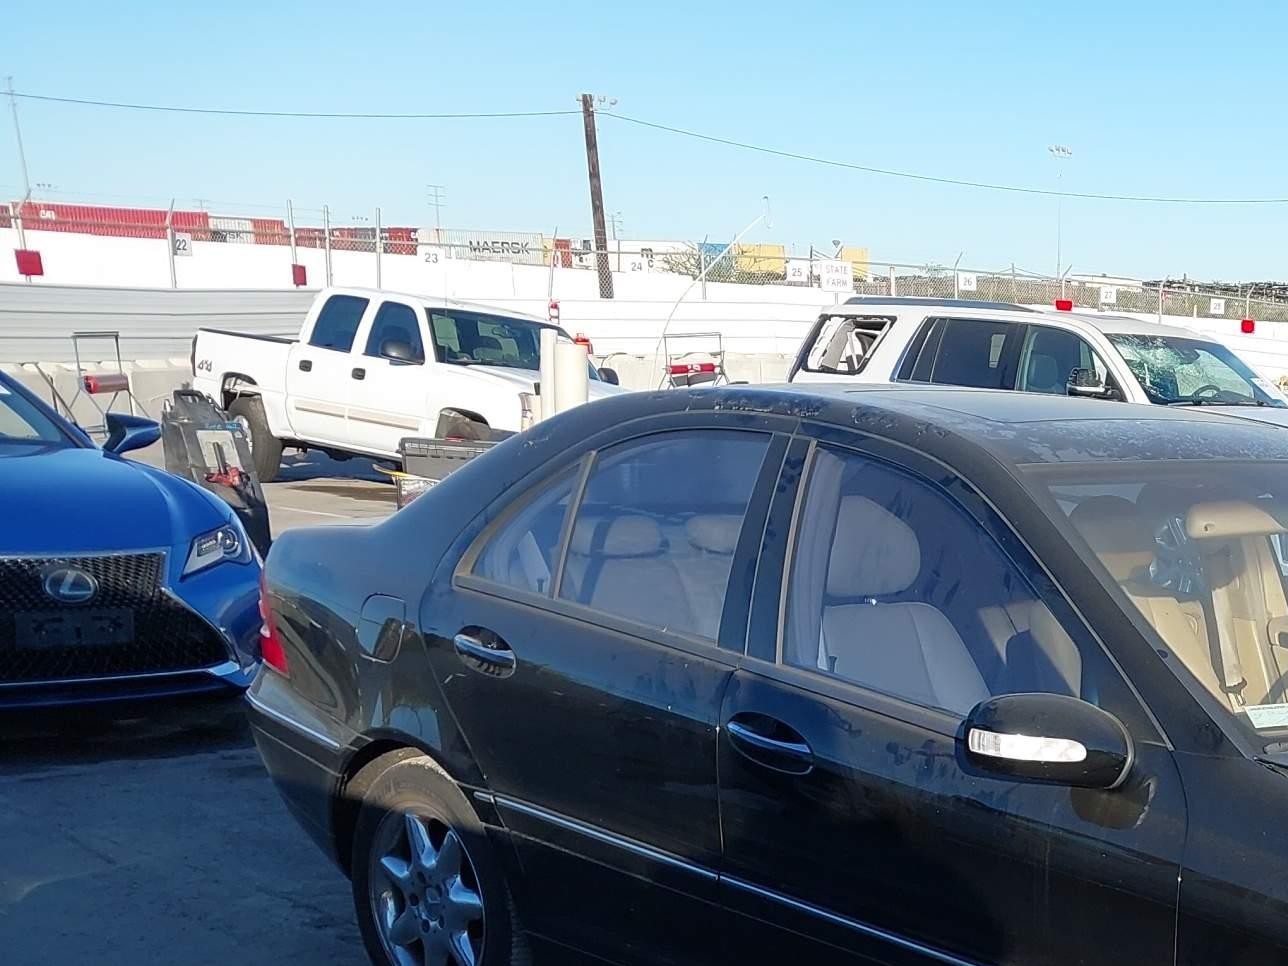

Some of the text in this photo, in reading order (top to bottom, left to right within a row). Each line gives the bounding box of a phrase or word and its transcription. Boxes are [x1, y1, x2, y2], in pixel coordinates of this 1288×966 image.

[176, 238, 188, 251] 22
[468, 240, 531, 255] MAERSK
[424, 252, 439, 264] 23
[631, 261, 643, 272] 24
[791, 267, 803, 277] 25
[825, 265, 849, 275] STATE
[826, 278, 848, 287] FARM
[963, 275, 973, 286] 26
